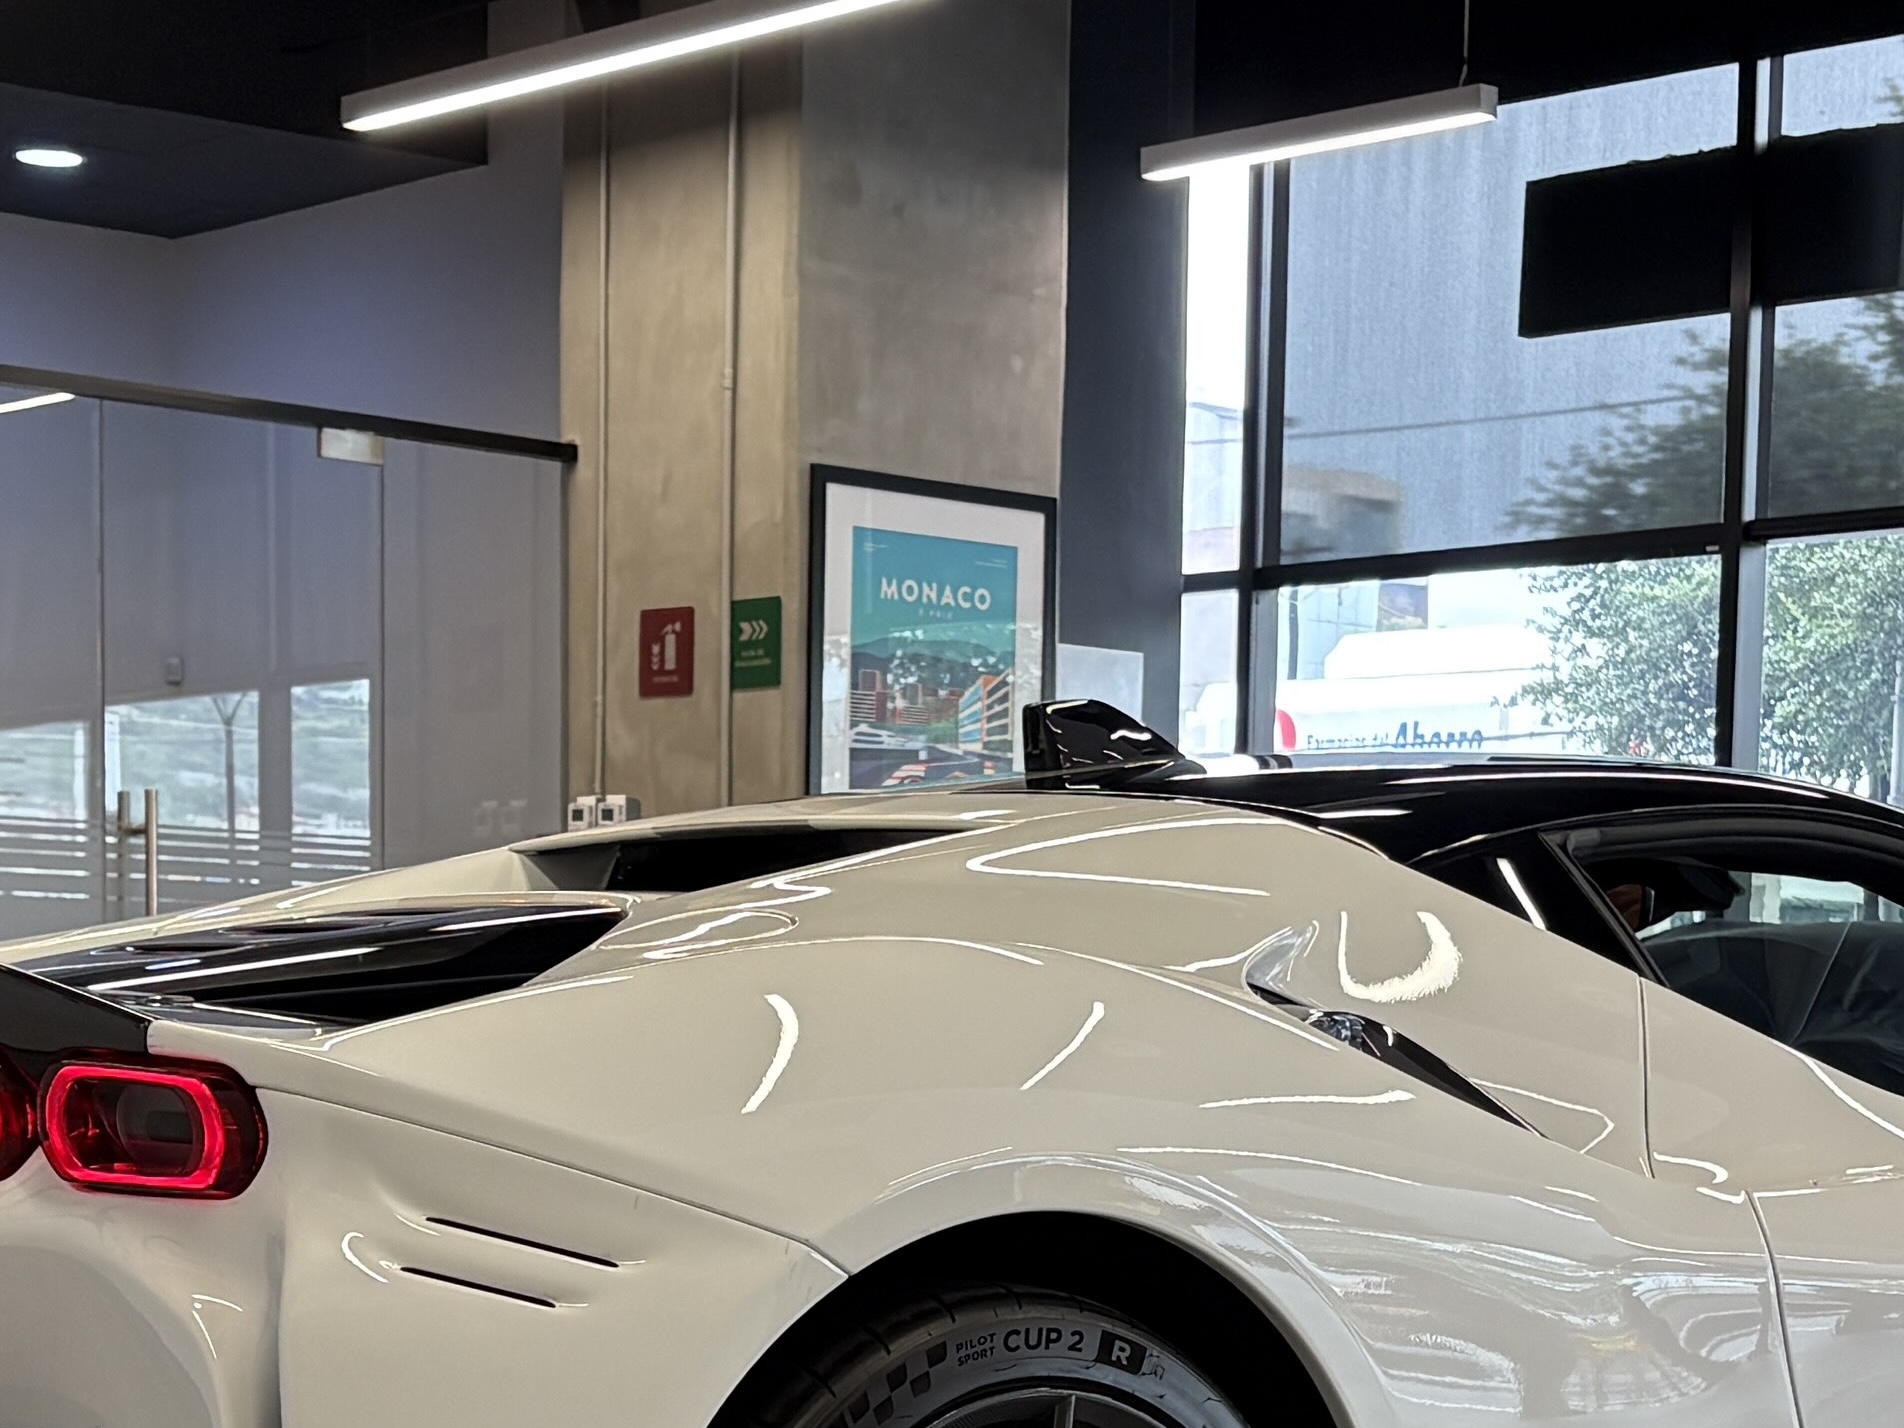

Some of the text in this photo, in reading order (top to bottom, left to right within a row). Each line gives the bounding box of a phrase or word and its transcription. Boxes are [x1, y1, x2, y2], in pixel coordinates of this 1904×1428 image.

[880, 576, 991, 611] MONACO
[955, 1332, 995, 1354] PILOT
[956, 1346, 996, 1367] SPORT
[1003, 1327, 1131, 1366] CUP 2 R
